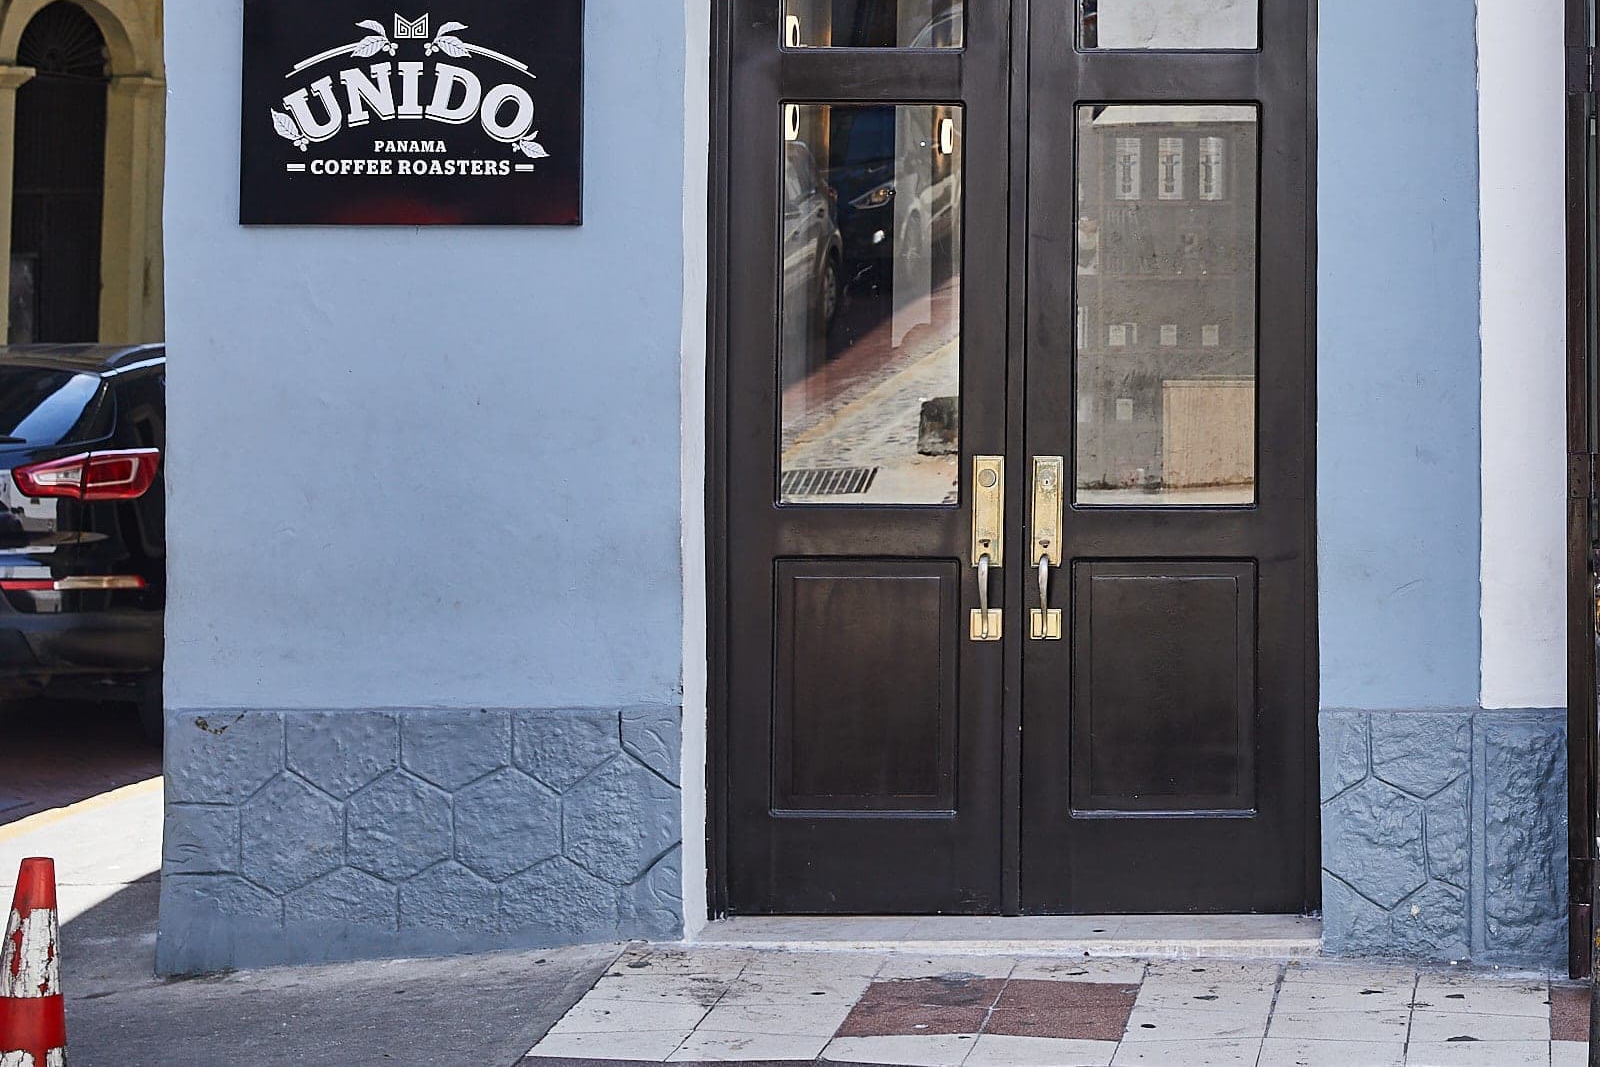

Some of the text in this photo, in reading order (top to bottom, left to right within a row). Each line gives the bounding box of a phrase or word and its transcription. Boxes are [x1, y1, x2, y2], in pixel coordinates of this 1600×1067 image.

[283, 61, 534, 143] UNIDO
[374, 140, 447, 153] PANAMA
[310, 159, 511, 176] COFFEE ROASTERS
